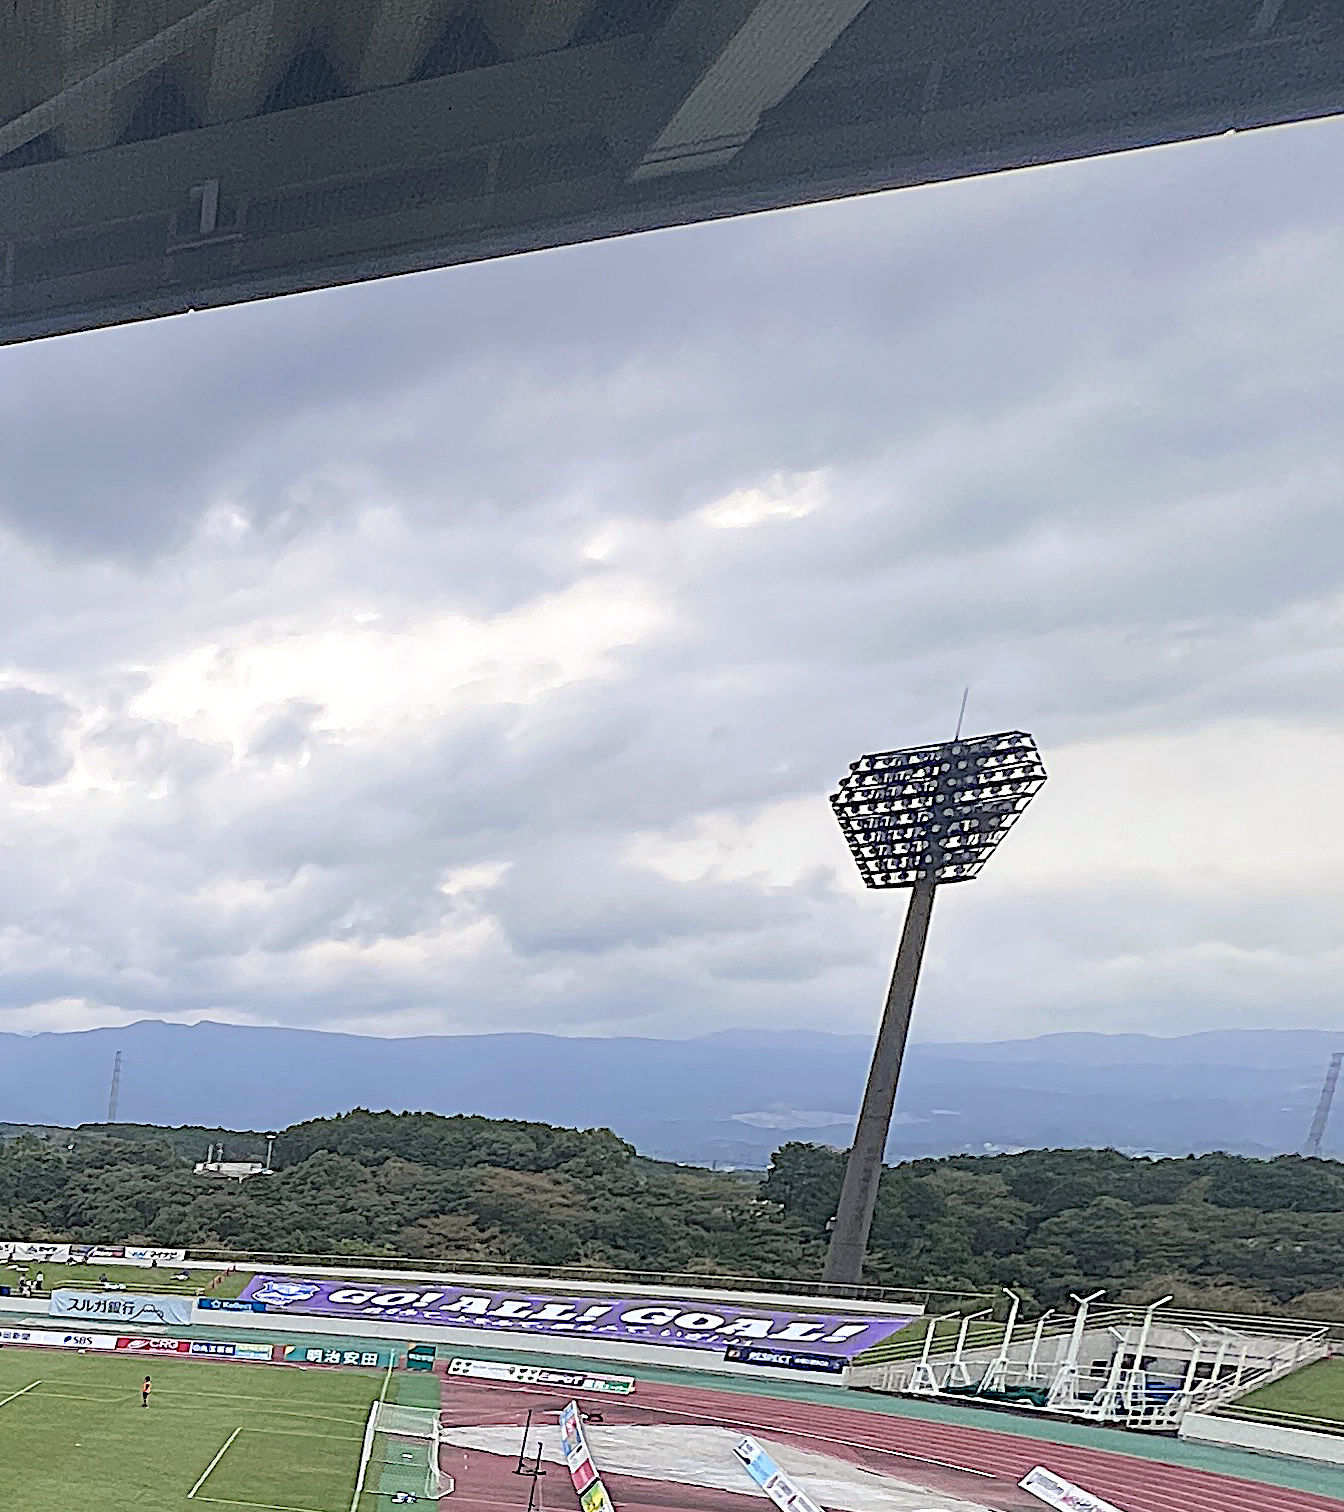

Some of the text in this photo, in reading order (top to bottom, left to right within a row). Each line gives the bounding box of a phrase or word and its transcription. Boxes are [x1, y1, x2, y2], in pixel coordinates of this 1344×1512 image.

[66, 1298, 136, 1315] スルガ銀行
[328, 1288, 444, 1308] GO!
[440, 1295, 612, 1322] ALL!
[620, 1306, 870, 1343] GOAL!
[73, 1335, 93, 1345] SBS
[305, 1349, 379, 1366] 明治安田
